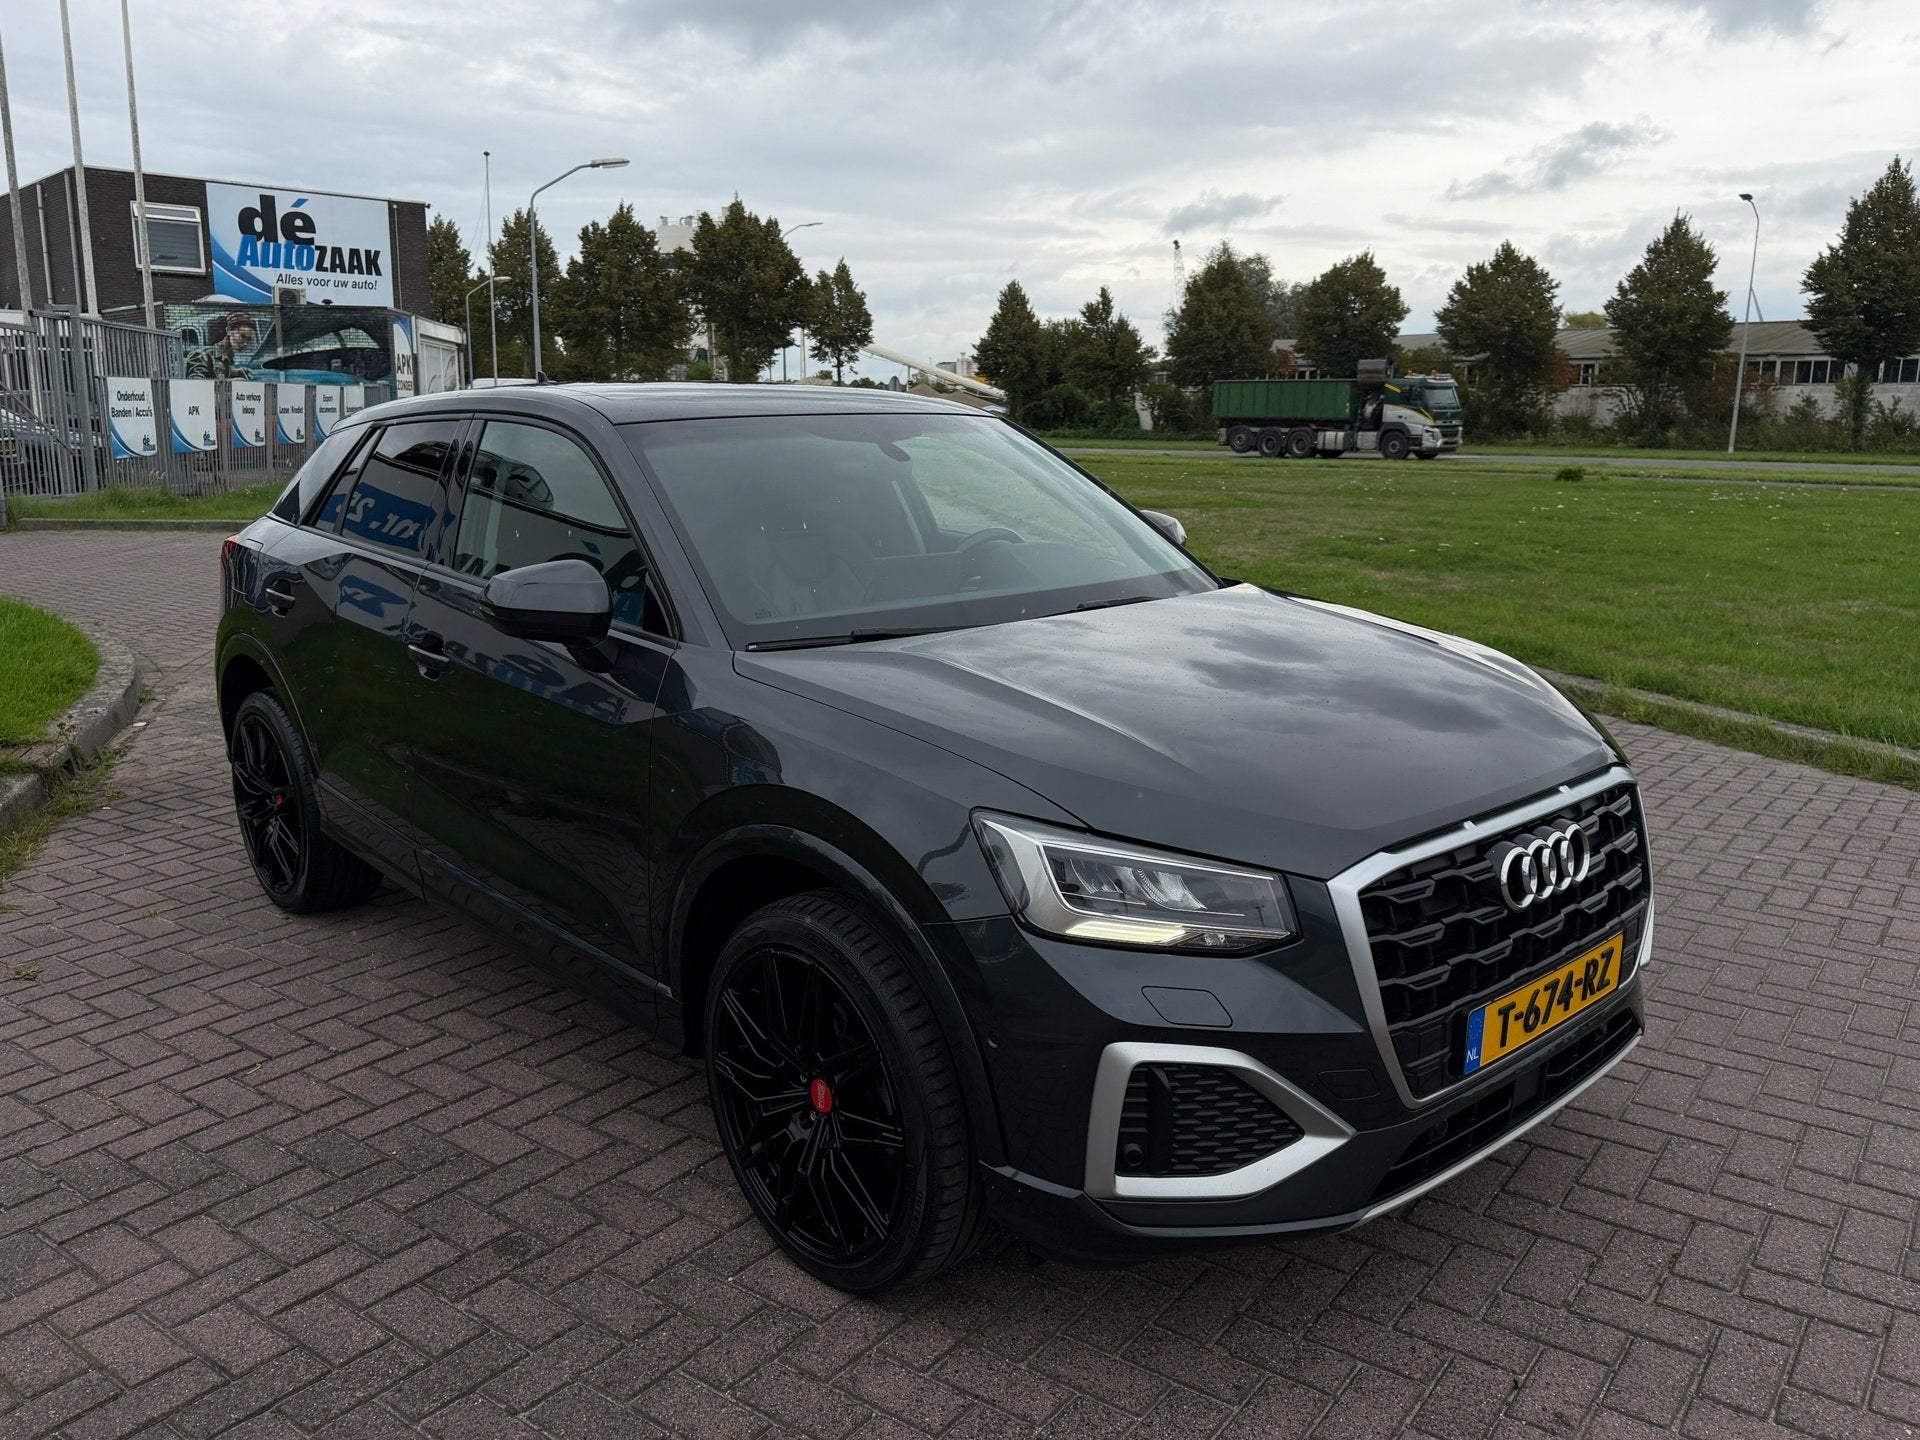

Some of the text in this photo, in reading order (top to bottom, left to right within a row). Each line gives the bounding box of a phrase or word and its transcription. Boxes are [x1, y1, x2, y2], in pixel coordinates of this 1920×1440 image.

[238, 194, 316, 244] dé
[236, 235, 382, 276] AutoZAAK
[276, 273, 377, 290] Alles voor uw auto!
[397, 353, 413, 374] APK
[117, 391, 145, 401] Onderhoud
[236, 392, 261, 403] Auto verkoop
[111, 407, 131, 417] Banden
[188, 406, 200, 415] APK
[242, 405, 255, 415] Inkoop
[1498, 947, 1615, 1048] T-674-RZ
[1466, 1046, 1479, 1063] NL
